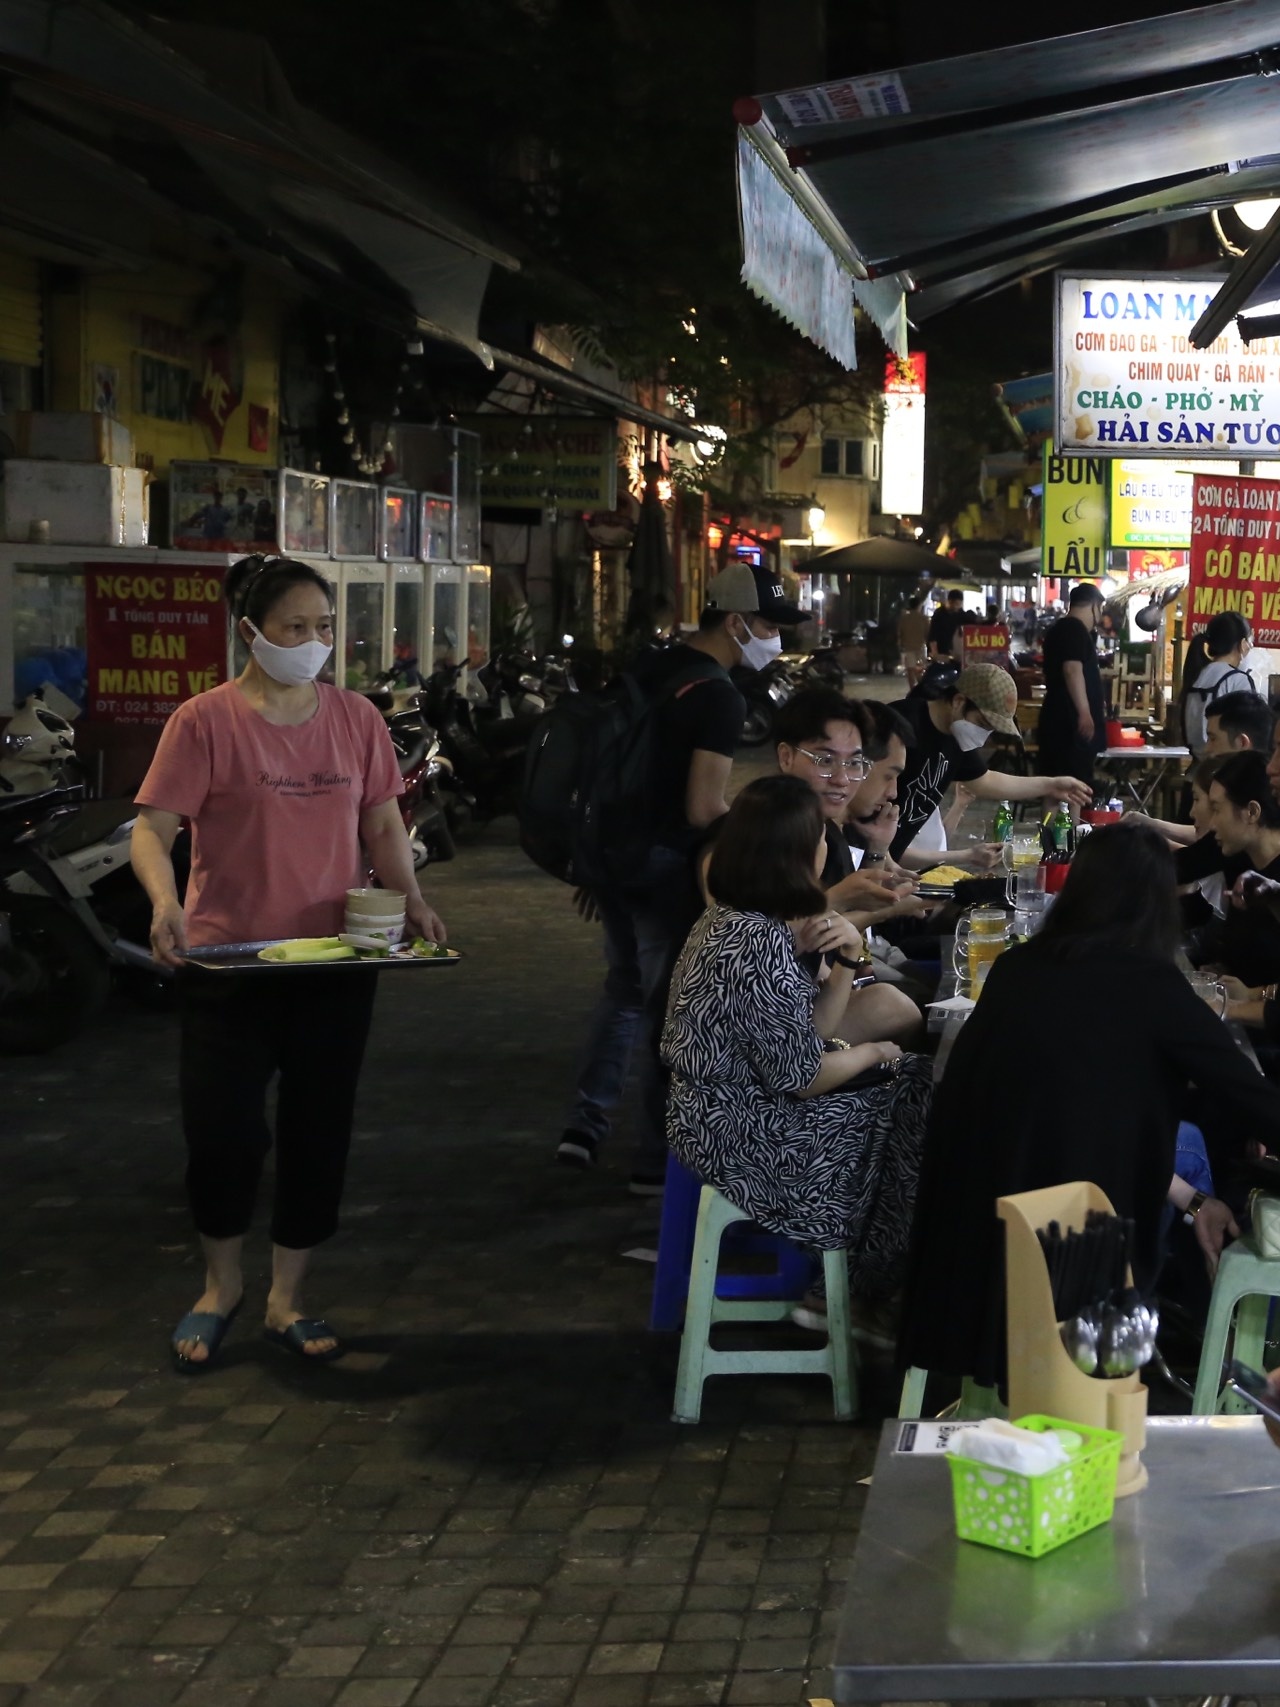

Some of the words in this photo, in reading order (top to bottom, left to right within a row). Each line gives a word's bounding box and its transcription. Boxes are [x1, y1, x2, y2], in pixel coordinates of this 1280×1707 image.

[1082, 290, 1164, 320] LOAN
[1075, 331, 1105, 351] CƠM
[1128, 361, 1163, 381] CHIM
[1167, 362, 1200, 383] QUAY
[1214, 360, 1232, 383] GÀ
[1077, 385, 1143, 410] CHÁO
[1165, 386, 1214, 411] PHỞ
[1229, 388, 1264, 412] MỲ
[1097, 413, 1150, 443] HẢI
[1157, 414, 1216, 444] SẢN
[1197, 484, 1222, 508] CƠM
[1224, 482, 1241, 509] GÀ
[1243, 488, 1275, 513] LOAN
[1213, 511, 1245, 538] TỐNG
[1247, 518, 1272, 540] DUY
[1047, 537, 1101, 575] LẨU
[1204, 543, 1233, 579] CÓ
[95, 575, 167, 607] NGỌC
[172, 571, 222, 603] BÉO
[1193, 586, 1256, 619] MANG
[158, 611, 183, 624] DUY
[130, 629, 187, 660] BÁN
[97, 667, 180, 696] MANG
[124, 700, 149, 713] 024
